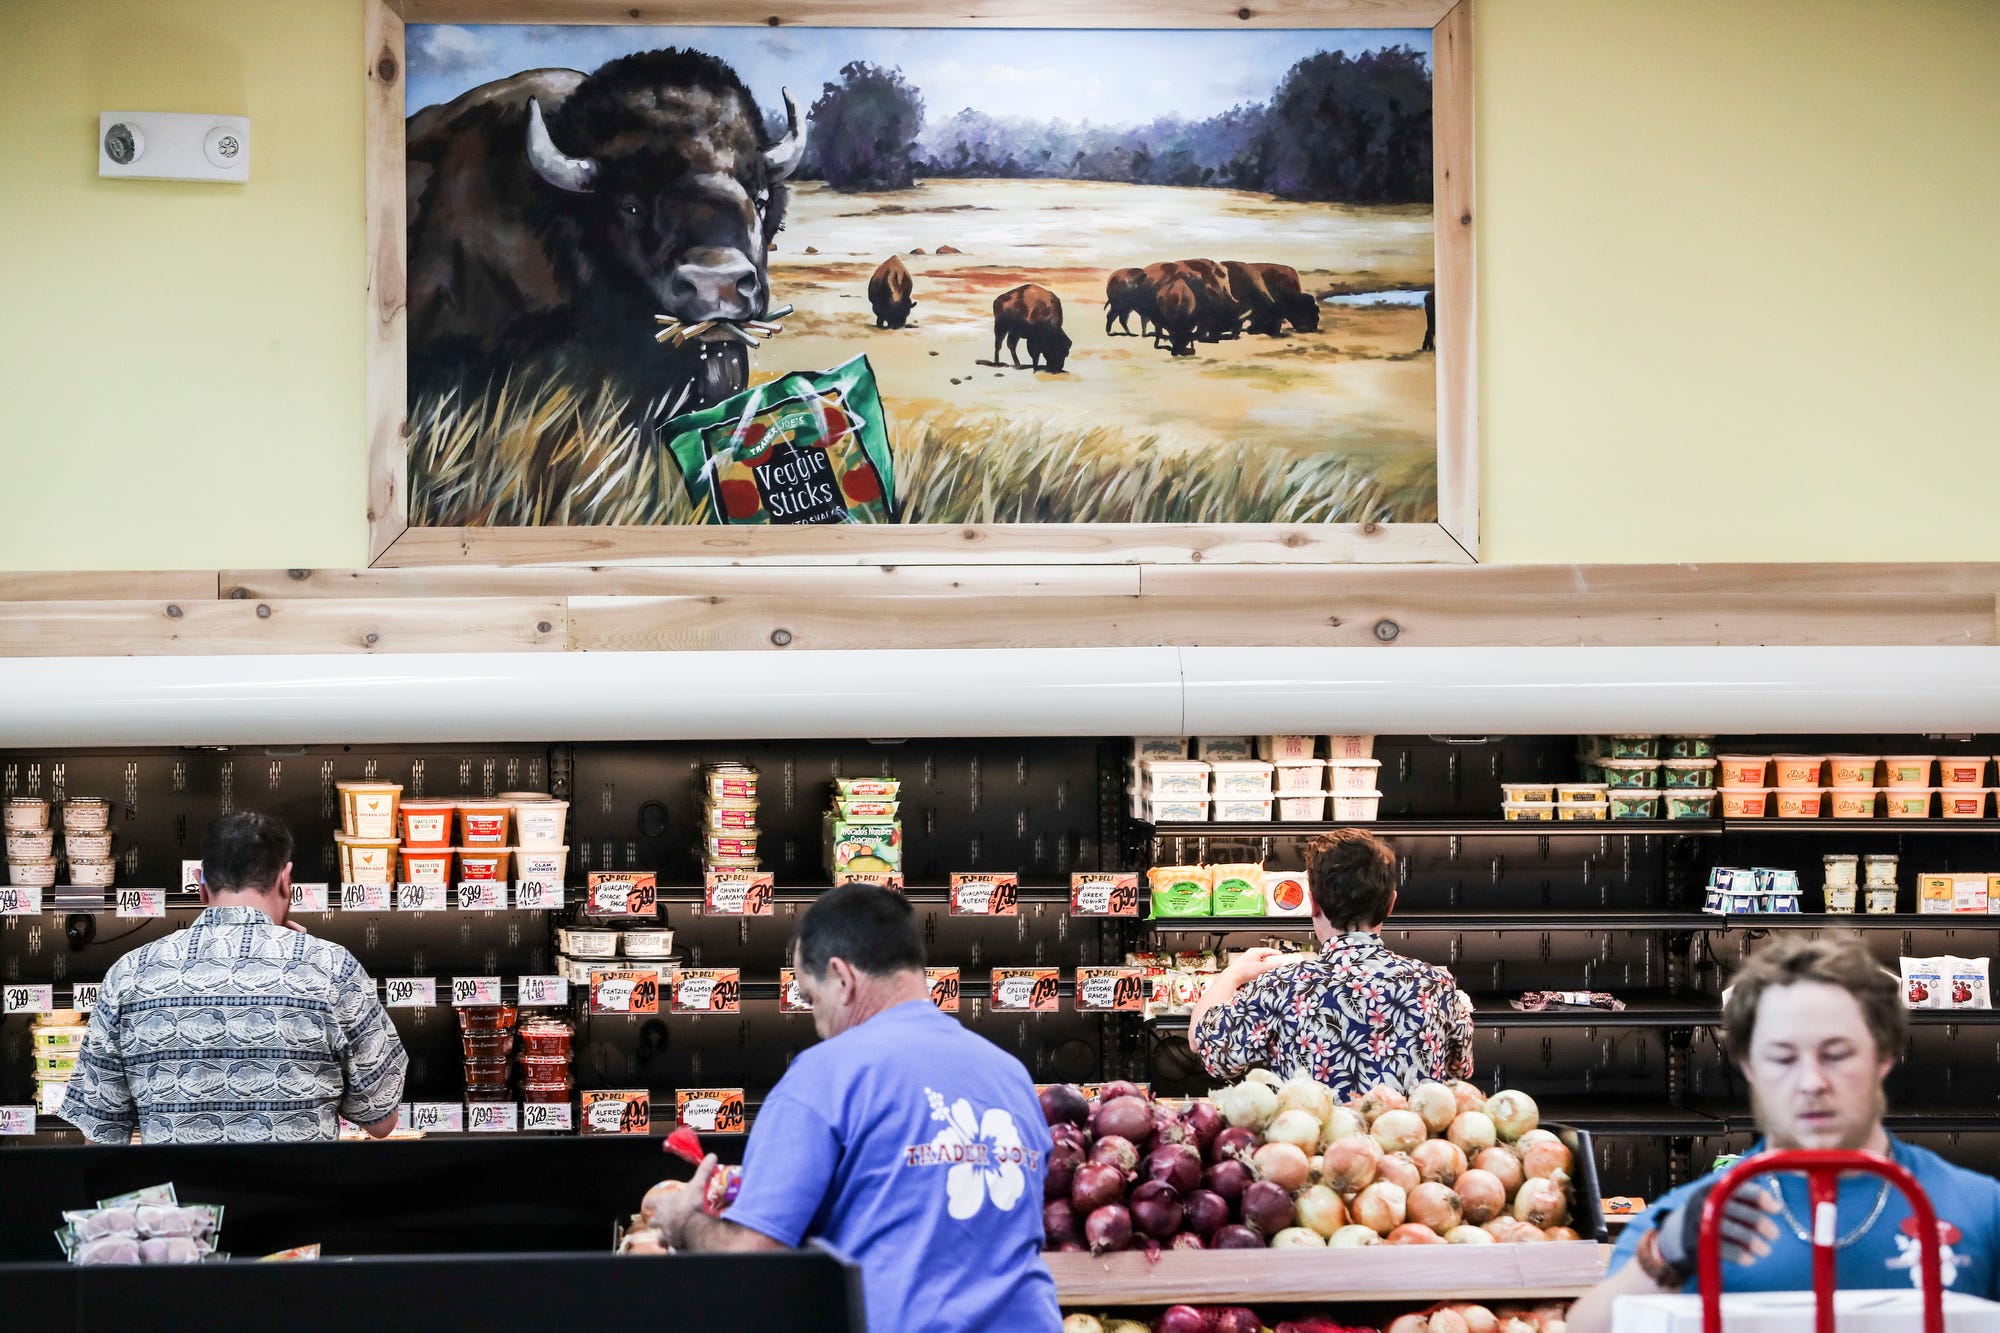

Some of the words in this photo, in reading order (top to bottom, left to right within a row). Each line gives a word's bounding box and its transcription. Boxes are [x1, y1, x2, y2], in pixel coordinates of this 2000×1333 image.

[750, 428, 778, 456] TRADER
[780, 416, 804, 431] JOE'S
[756, 451, 826, 490] Veggie
[460, 885, 481, 908] 3.99
[388, 981, 413, 1002] 3.99
[455, 980, 476, 1002] 3.99
[472, 1106, 492, 1127] 2.99
[526, 1106, 547, 1127] 3.29
[907, 1143, 990, 1168] TRADER
